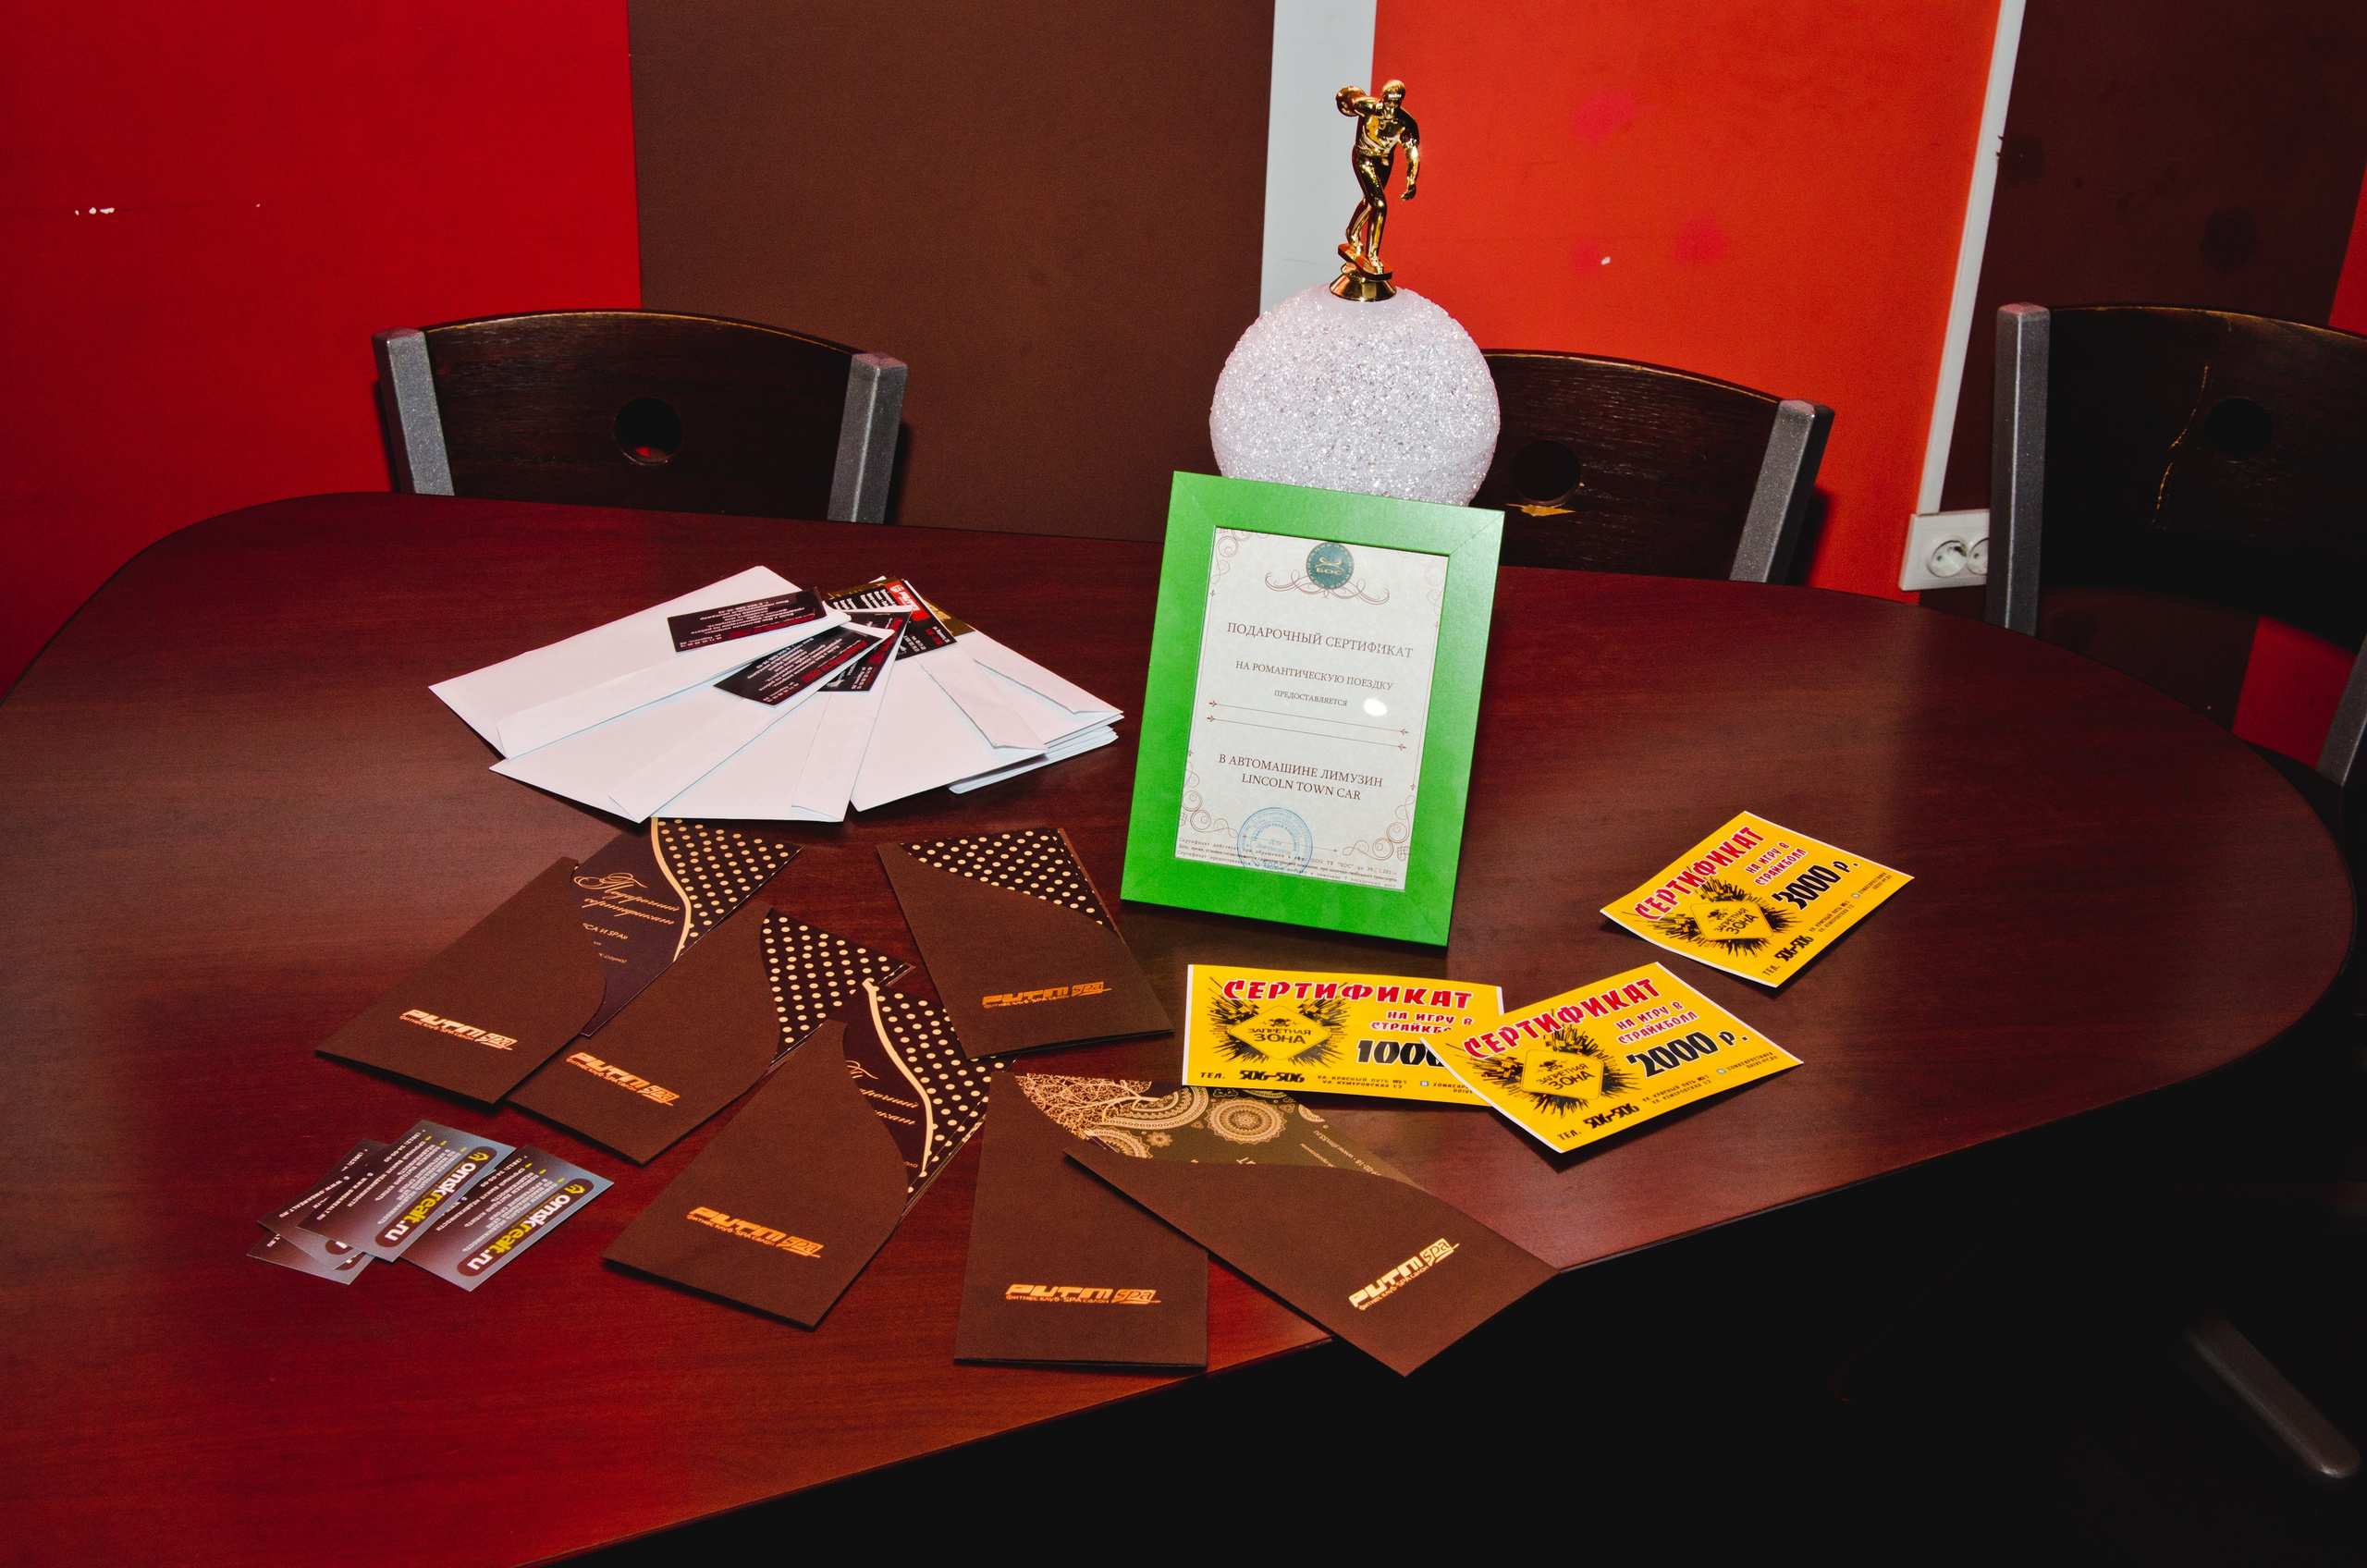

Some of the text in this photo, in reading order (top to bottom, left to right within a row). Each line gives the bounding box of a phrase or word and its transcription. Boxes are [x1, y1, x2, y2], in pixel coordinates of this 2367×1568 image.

[1227, 622, 1414, 658] ПОДАРОЧНЫЙ СЕРТИФИКАТ
[1235, 660, 1393, 691] НА РОМАНТИЧЕСКУЮ ПОЕЗДКУ
[1274, 690, 1348, 706] ПРЕДОСТАВЛЯЕТСЯ
[1219, 753, 1383, 787] В АВТОМАШИНЕ ЛИМУЗИН
[1241, 773, 1362, 801] LINCOLN TOWN CAR
[1745, 841, 1791, 875] НА ИГРУ В
[1754, 848, 1808, 886] СТРАЙКБОЛЛ
[1634, 826, 1765, 921] СЕРТИФИКАТ
[1771, 864, 1843, 911] 3000
[1714, 907, 1749, 933] ЗАПРЕТНАЯ
[1725, 913, 1759, 935] ЗОНА
[1222, 980, 1473, 1010] СЕРТИФИКАТ
[1248, 1026, 1311, 1036] ЗАПРЕТНАЯ
[1370, 1022, 1453, 1034] СТРАЙКБО
[1387, 1011, 1408, 1020] НА
[1416, 1013, 1455, 1024] ИГРУ
[1463, 977, 1662, 1060] СЕРТИФИКАТ
[1616, 1001, 1684, 1031] НА ИГРУ В
[1617, 1011, 1699, 1045] СТРАЙКБОЛЛ
[1254, 1033, 1306, 1045] ЗОНА
[1625, 1031, 1720, 1078] 2000
[1200, 1072, 1226, 1080] ТЕЛ.
[1536, 1063, 1589, 1084] ЗАПРЕТНАЯ
[1548, 1071, 1596, 1091] ЗОНА
[1557, 1131, 1582, 1141] ТЕЛ.
[385, 1162, 476, 1242] omskrealt.ru
[467, 1194, 570, 1271] omskrealt.ru
